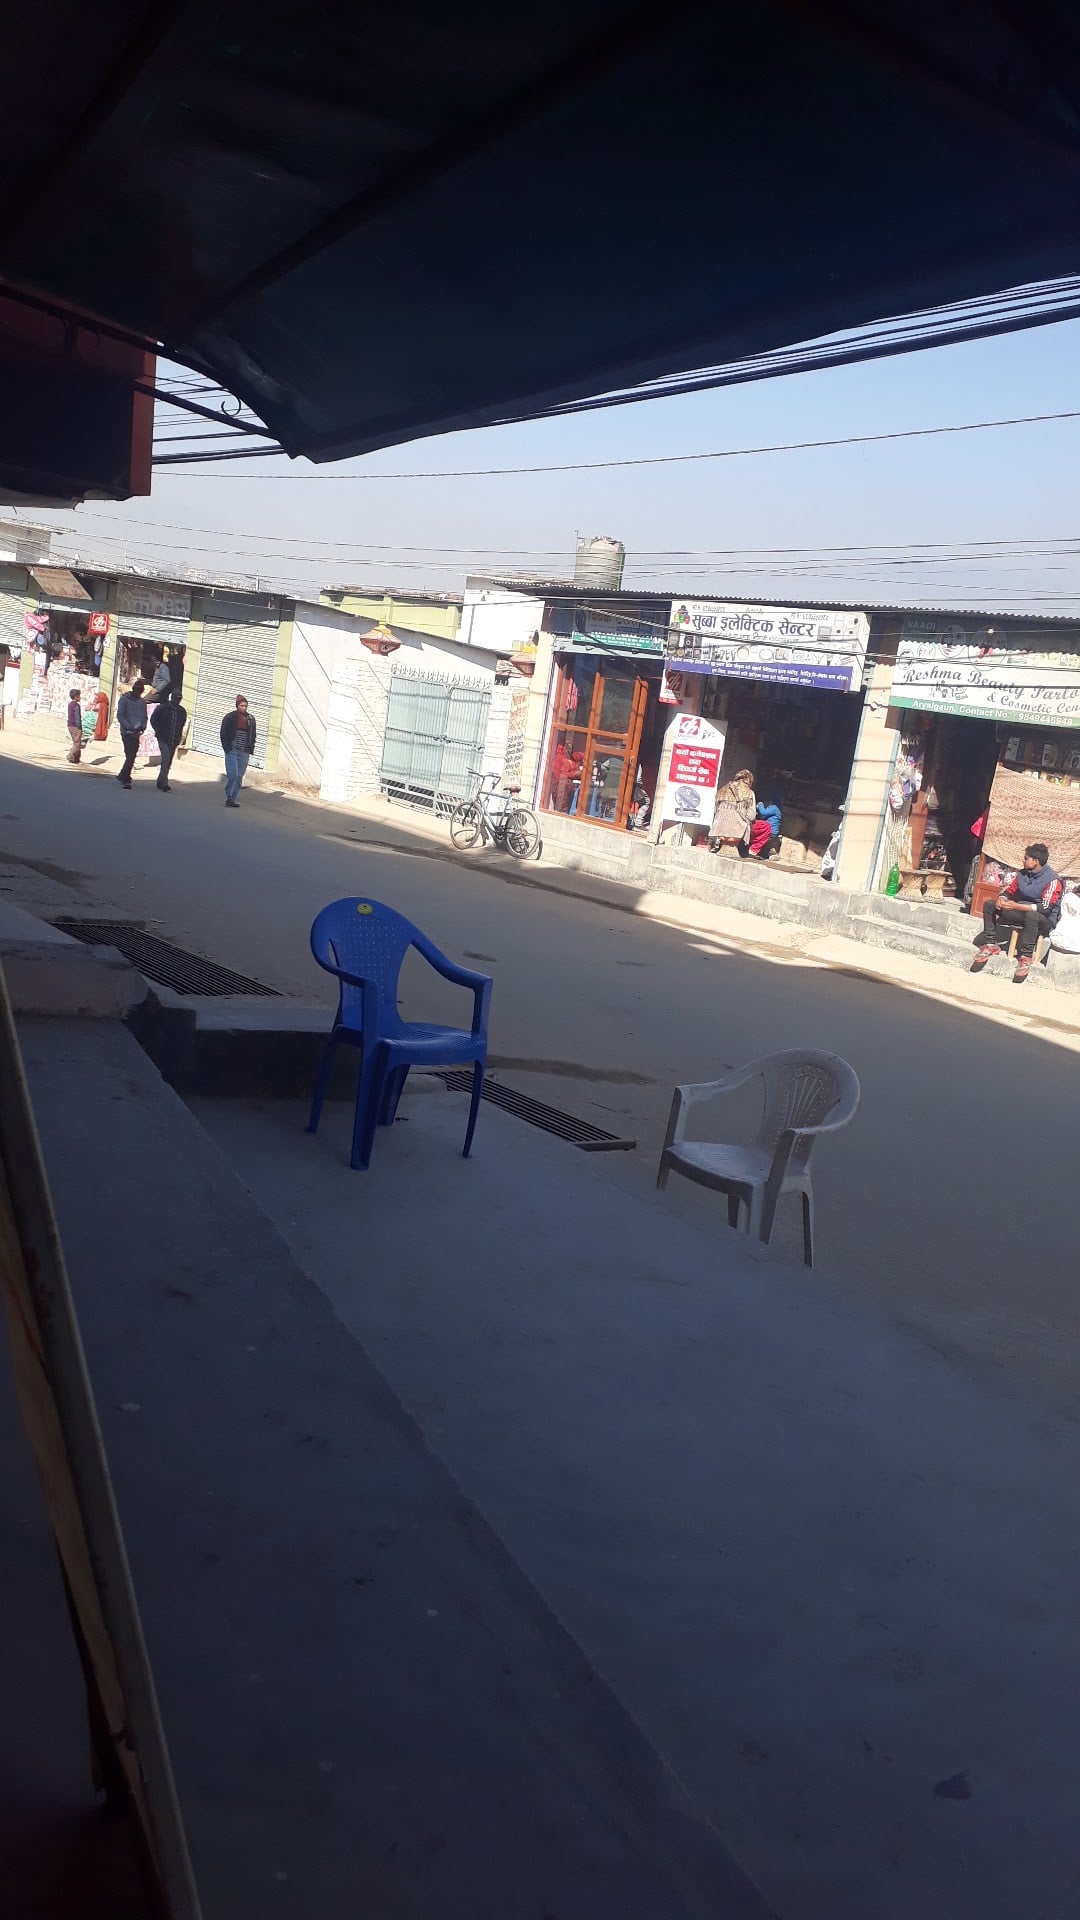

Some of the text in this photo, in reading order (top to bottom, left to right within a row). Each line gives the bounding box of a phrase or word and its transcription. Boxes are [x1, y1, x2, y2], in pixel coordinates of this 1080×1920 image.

[778, 616, 817, 637] सेन्टर
[903, 666, 962, 683] Reshma
[967, 670, 1025, 699] Beauty
[959, 705, 993, 717] Contact
[1000, 695, 1052, 714] Cosmetic
